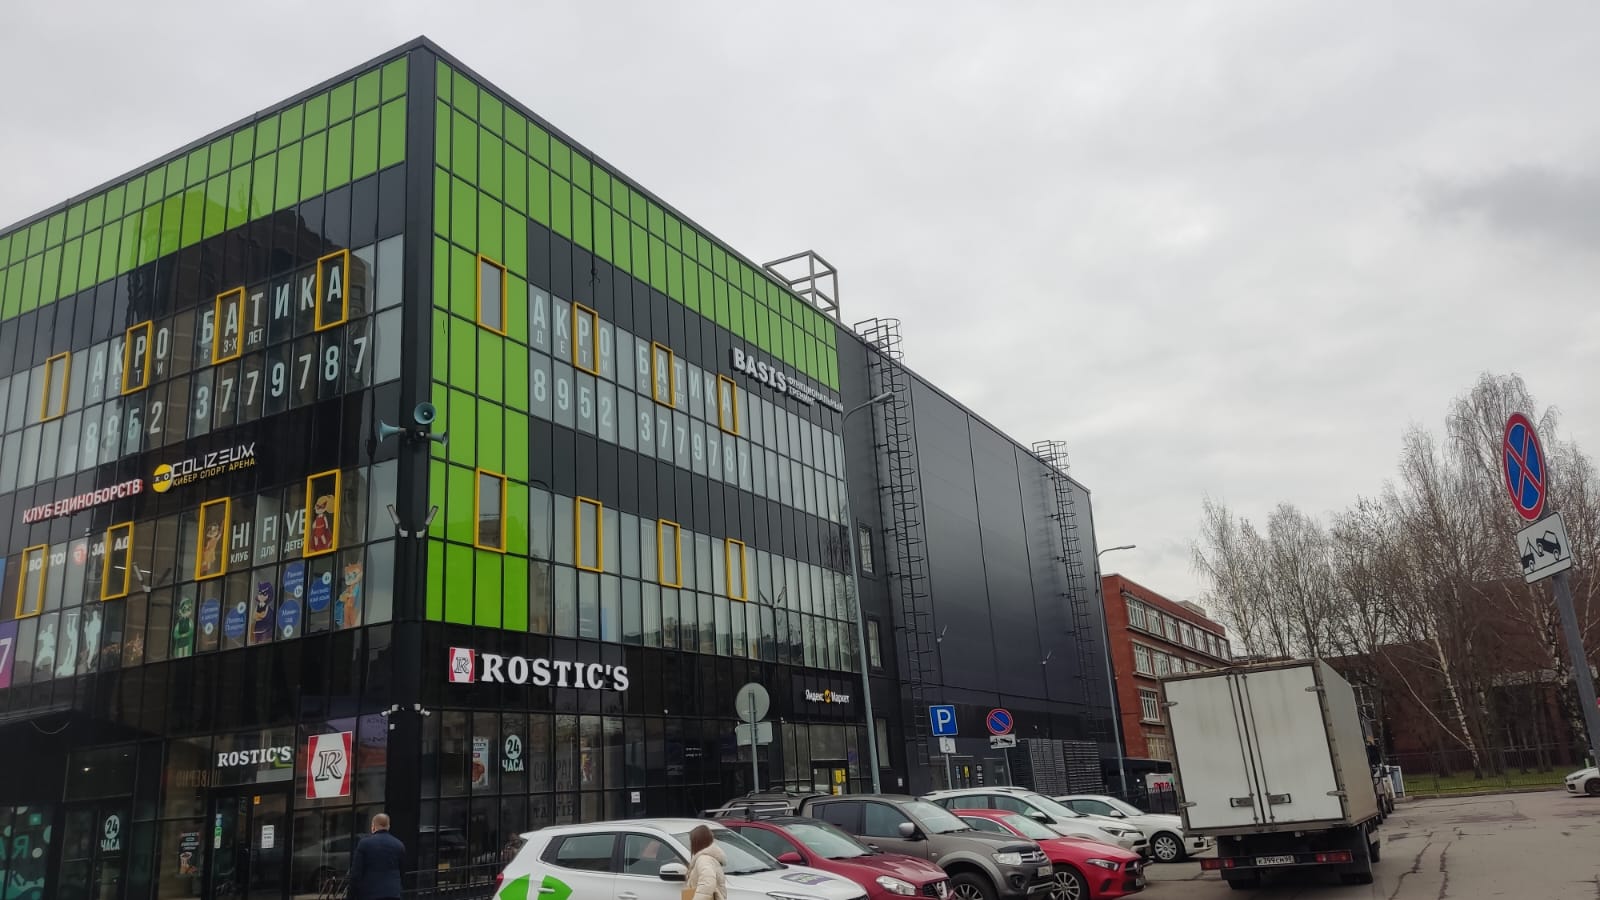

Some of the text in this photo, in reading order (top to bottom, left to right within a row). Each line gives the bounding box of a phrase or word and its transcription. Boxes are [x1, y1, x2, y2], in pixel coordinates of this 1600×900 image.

[91, 264, 342, 383] АКРО БАТИКА
[248, 328, 264, 345] ЛЕТ
[533, 294, 731, 414] АКРО БАТИКА
[734, 347, 787, 392] BASIS
[86, 337, 368, 457] 8952 3779787
[533, 368, 748, 477] 8952 3779787
[173, 458, 256, 488] КИБЕР СПОРТ АРЕНА
[22, 478, 143, 524] КЛУБ ЕДИНОБОРСТВ
[232, 522, 250, 550] HI
[230, 550, 249, 564] КЛУБ
[260, 545, 276, 559] ДЛЯ
[481, 653, 630, 691] ROSTIC'S
[806, 689, 850, 704] Яндекс Маркет
[937, 708, 951, 733] P
[218, 746, 292, 768] ROSTIC'S
[507, 739, 520, 756] 24
[502, 760, 524, 772] ЧАСА
[106, 820, 119, 834] 24
[100, 839, 120, 852] ЧАСА
